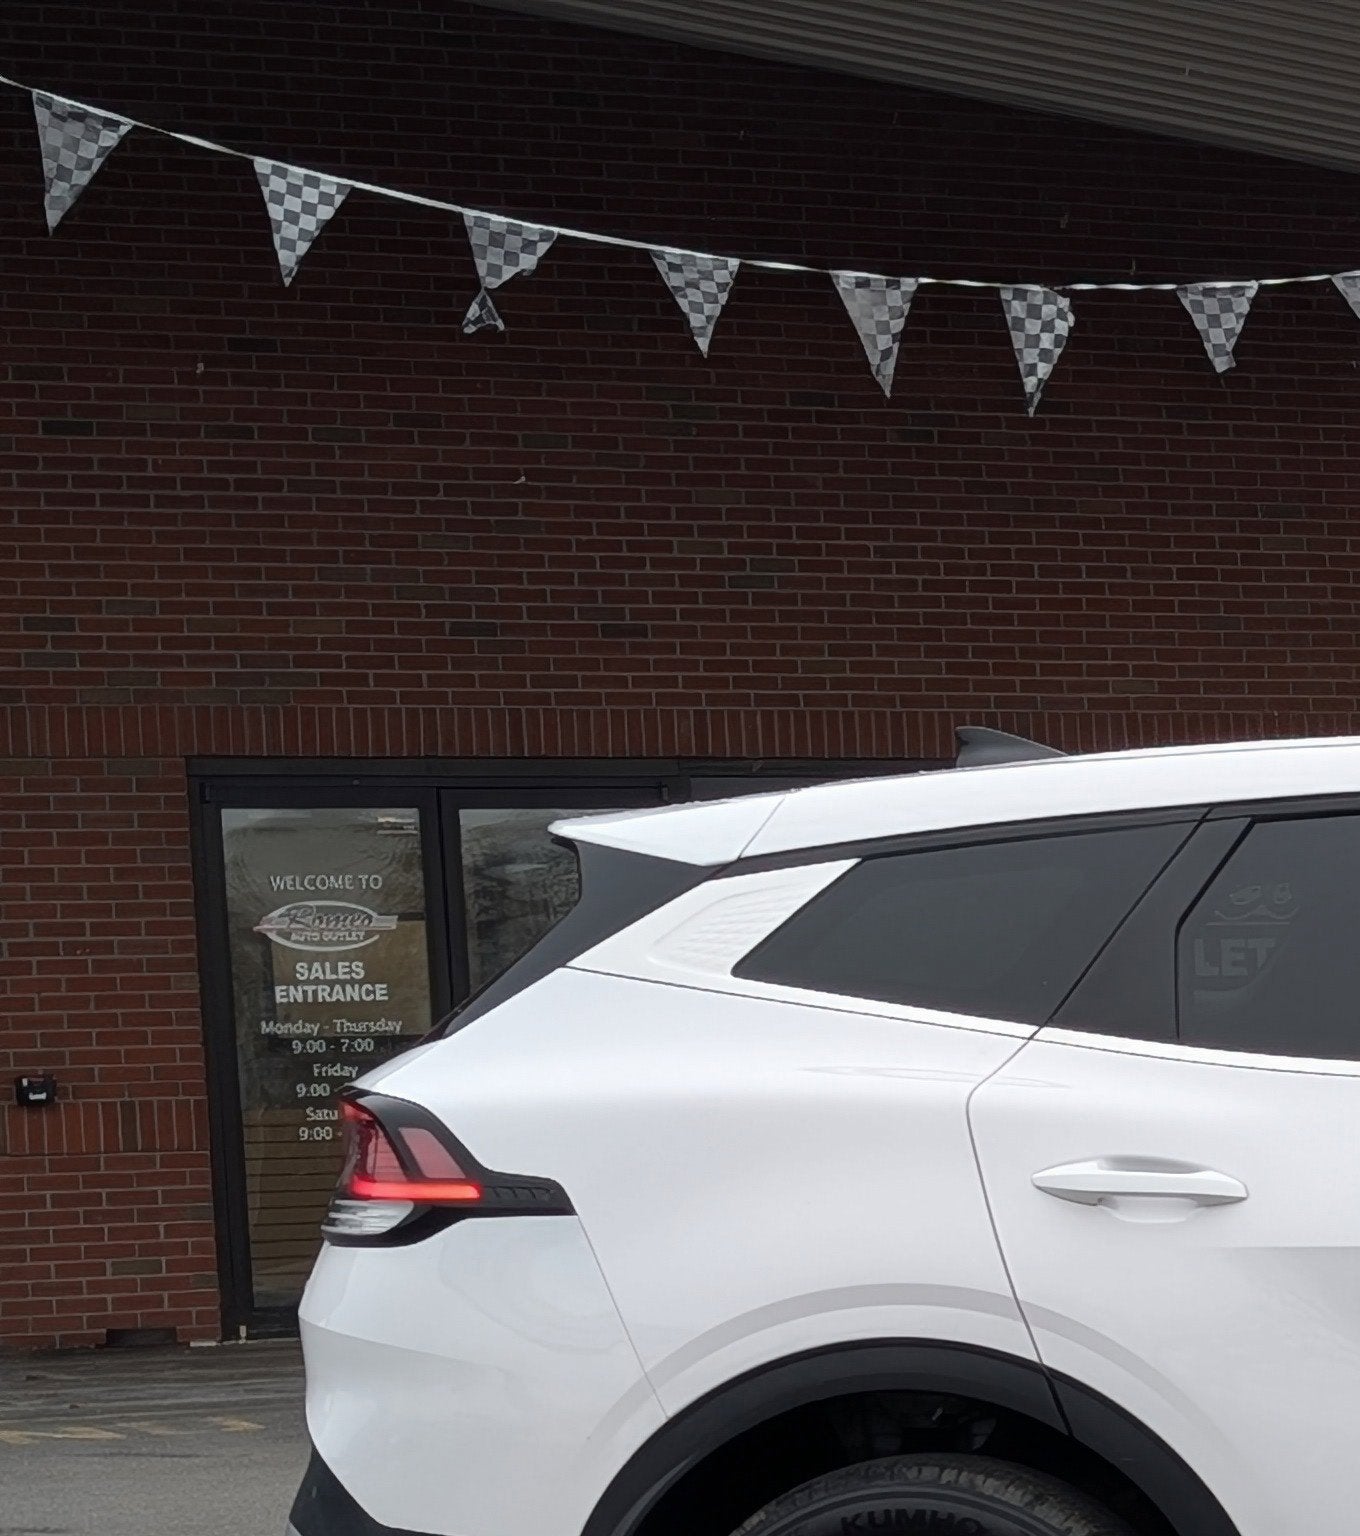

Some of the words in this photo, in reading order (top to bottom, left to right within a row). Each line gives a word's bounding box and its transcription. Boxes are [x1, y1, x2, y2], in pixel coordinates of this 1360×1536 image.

[270, 875, 354, 891] WELCOME
[358, 874, 382, 890] TO
[295, 961, 365, 980] SALES
[274, 983, 389, 1003] ENTRANCE
[260, 1020, 320, 1036] Monday
[333, 1018, 402, 1034] Thursday
[340, 1038, 374, 1052] 7:00
[313, 1063, 359, 1078] Friday
[305, 1107, 339, 1121] Satu
